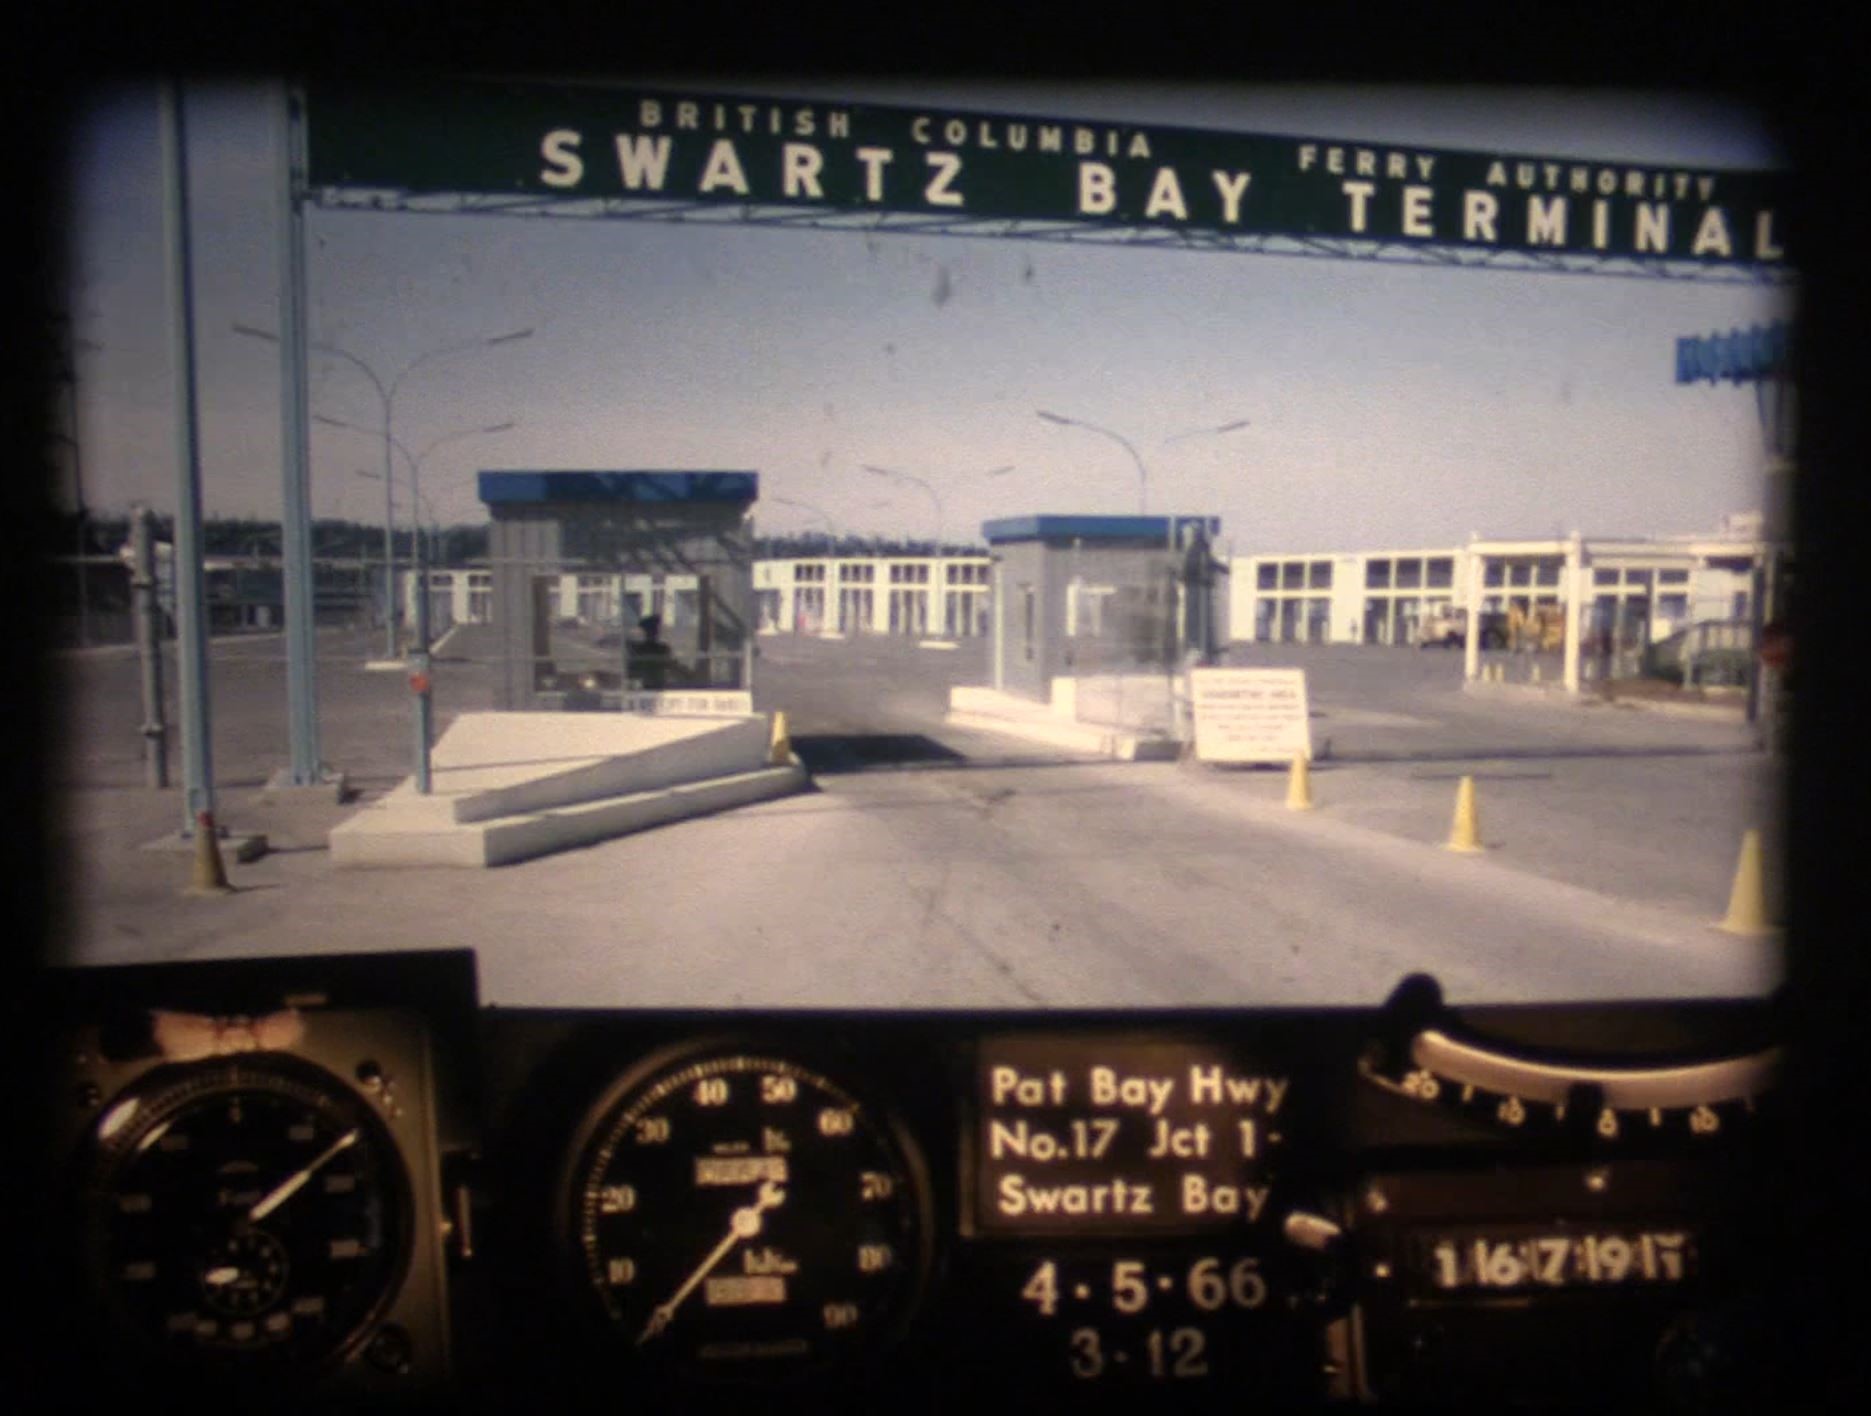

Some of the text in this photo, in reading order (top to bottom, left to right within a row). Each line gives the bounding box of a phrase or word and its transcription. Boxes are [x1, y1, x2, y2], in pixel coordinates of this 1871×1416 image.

[639, 101, 1715, 201] BRITISH COLUMBIA FERRY AUTHORITY
[541, 130, 1784, 259] SWARTZ BAY TERMINAL
[762, 1075, 797, 1104] 50
[992, 1065, 1288, 1115] Pat Bay Hwy
[635, 1117, 669, 1144] 30
[817, 1107, 853, 1136] 60
[990, 1119, 1120, 1160] No.17
[1148, 1119, 1211, 1158] Jct
[999, 1174, 1269, 1221] Swartz Bay
